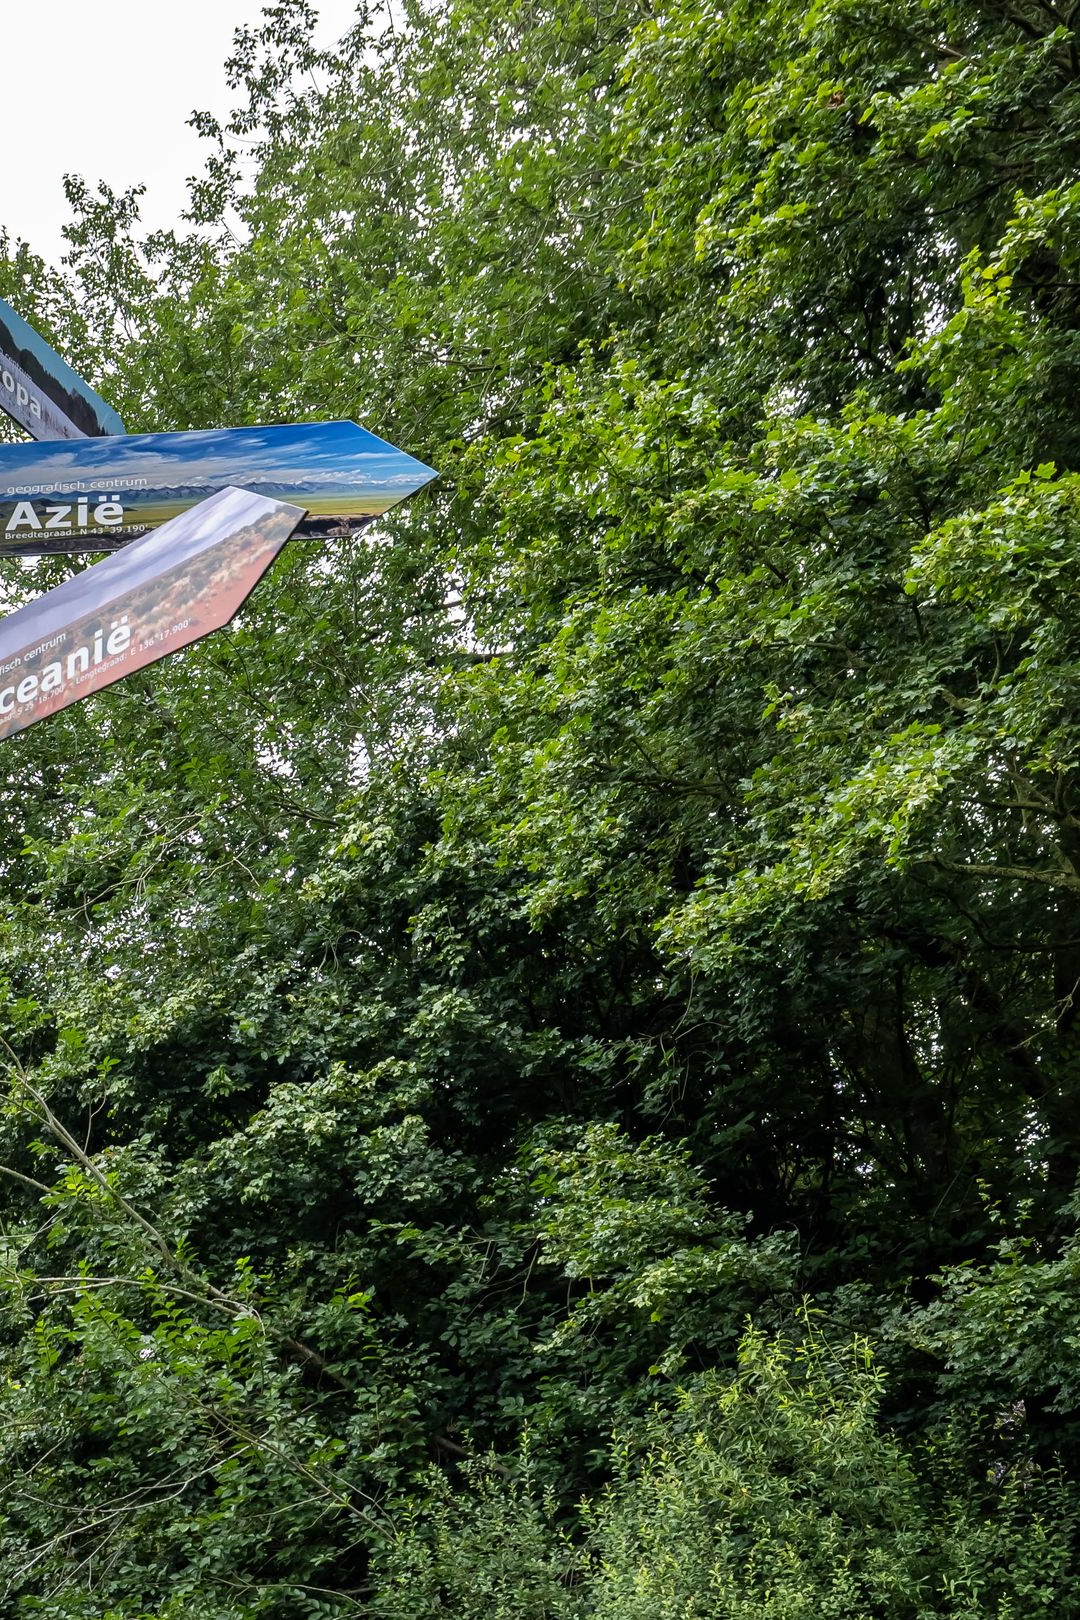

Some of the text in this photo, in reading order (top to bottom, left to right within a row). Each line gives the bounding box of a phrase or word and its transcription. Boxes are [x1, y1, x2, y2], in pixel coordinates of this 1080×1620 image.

[7, 477, 148, 497] geografisch centrum
[5, 494, 124, 531] Azië
[4, 529, 76, 540] Breedtegraad:
[23, 632, 67, 663] centrum
